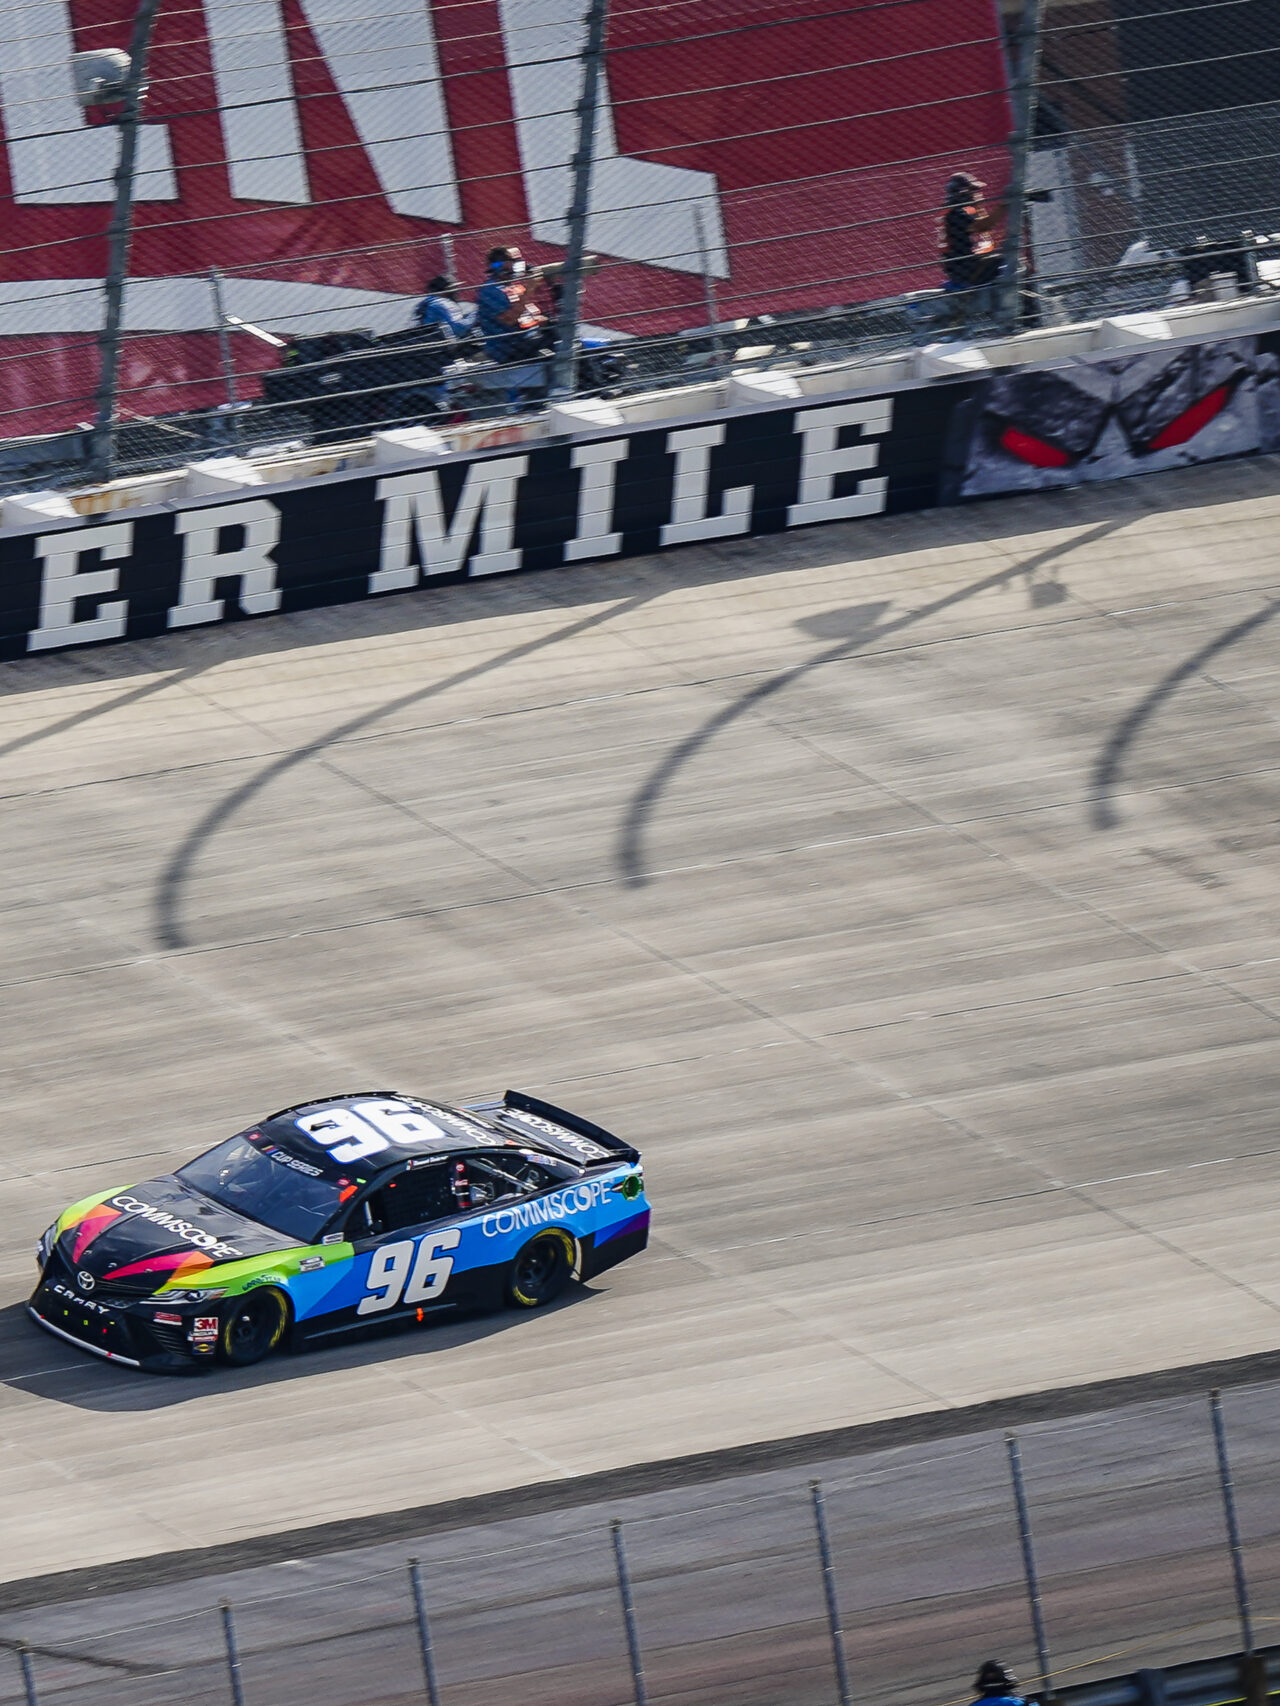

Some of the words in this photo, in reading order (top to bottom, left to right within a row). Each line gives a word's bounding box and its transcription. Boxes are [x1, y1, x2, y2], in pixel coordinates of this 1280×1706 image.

[368, 399, 892, 595] MILE
[296, 1100, 445, 1163] 96
[270, 1151, 293, 1164] CUP
[289, 1159, 324, 1177] SERIES
[111, 1195, 240, 1257] COMMSCOPE
[482, 1178, 613, 1237] COMMSCOPE
[53, 1284, 110, 1314] CAMRY
[356, 1228, 461, 1315] 96
[195, 1318, 218, 1331] 3M
